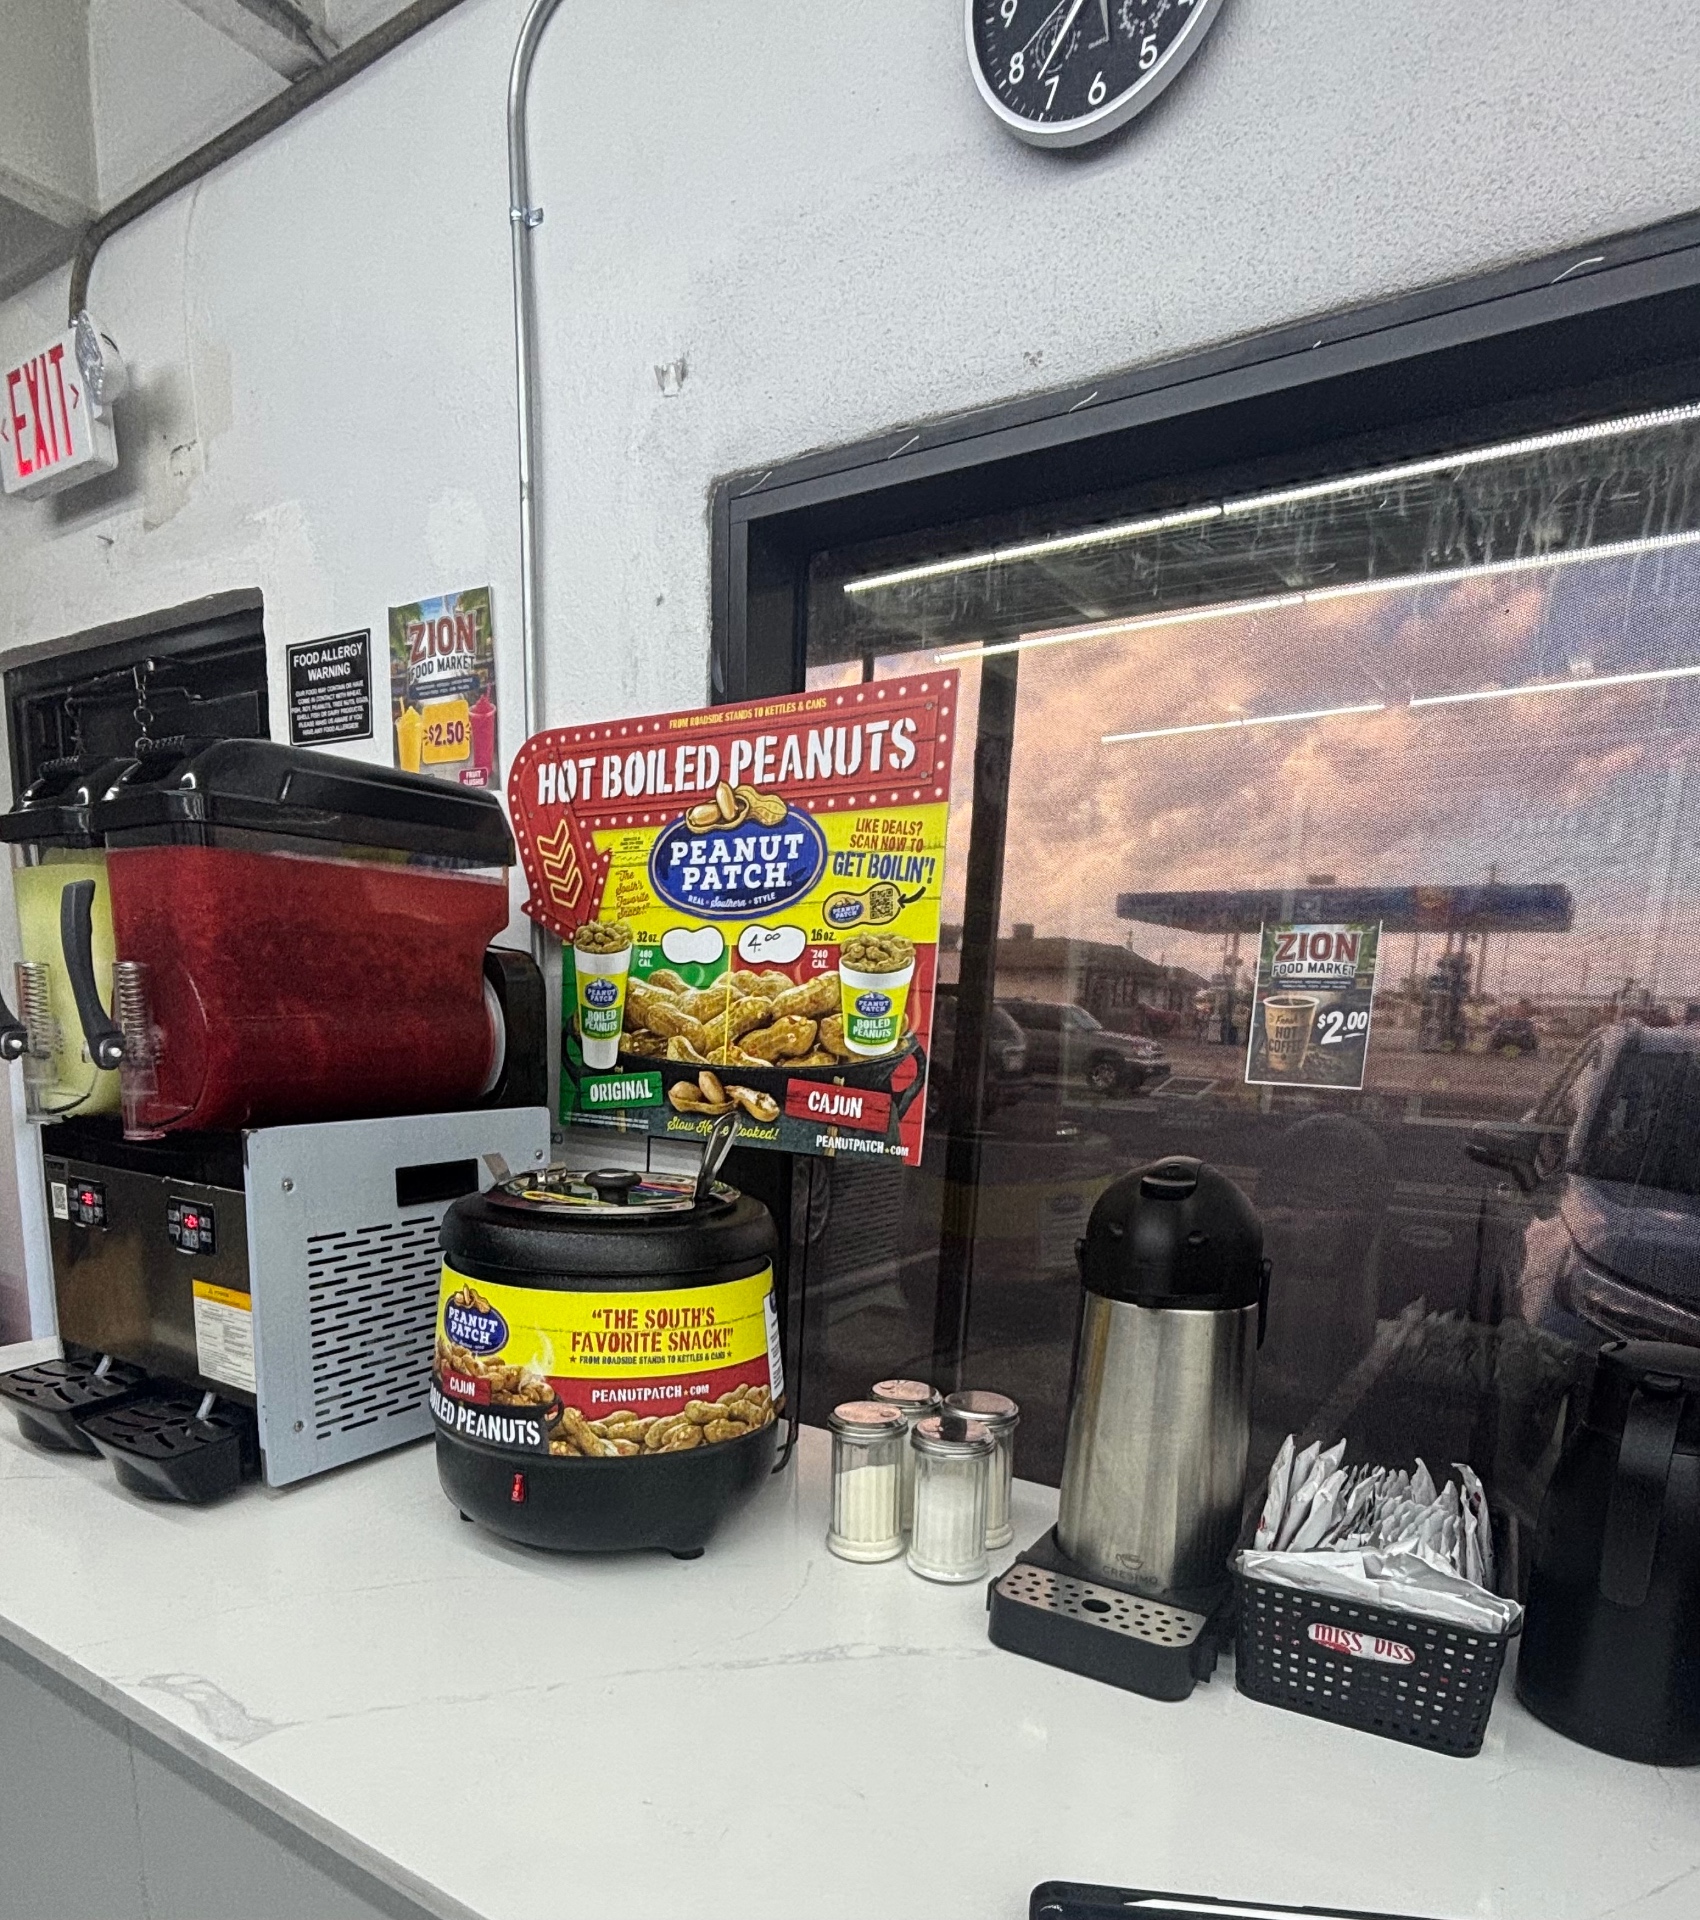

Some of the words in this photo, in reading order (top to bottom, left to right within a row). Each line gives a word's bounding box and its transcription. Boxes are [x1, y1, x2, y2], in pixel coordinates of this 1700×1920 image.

[1000, 0, 1017, 28] 9
[1138, 34, 1157, 69] 5
[1008, 52, 1024, 84] 8
[1044, 76, 1059, 111] 7
[1087, 71, 1106, 105] 6
[7, 342, 73, 477] EXIT
[409, 611, 476, 666] ZION
[293, 651, 319, 668] FOOD
[320, 642, 363, 663] ALLERGY
[307, 662, 351, 681] WARNING
[410, 660, 434, 680] FOOD
[437, 655, 475, 673] MARKET
[669, 717, 689, 730] FROM
[690, 713, 723, 726] ROADSIDE
[725, 708, 752, 722] STANDS
[754, 708, 764, 718] TO
[765, 702, 796, 716] KETTLES
[798, 701, 804, 711] &
[805, 698, 827, 710] CANS
[428, 720, 464, 746] $2.50
[537, 757, 596, 806] HOT
[601, 745, 720, 799] BOILED
[728, 717, 917, 789] PEANUTS
[856, 818, 879, 833] LIKE
[881, 819, 923, 836] DEALS?
[670, 833, 804, 866] PEANUT
[849, 834, 879, 850] SCAN
[881, 836, 907, 852] NOW
[910, 838, 924, 853] TO
[681, 862, 789, 891] PATCH
[832, 851, 866, 878] GET
[867, 853, 935, 884] BOILIN'!
[687, 894, 705, 906] REAL
[710, 896, 747, 908] Southern
[753, 892, 776, 905] STYLE
[833, 904, 860, 915] PEANUT
[835, 911, 858, 919] PATCH
[637, 931, 648, 943] 32
[811, 928, 823, 941] 16
[812, 949, 828, 959] 240
[1275, 931, 1362, 963] ZION
[1273, 963, 1304, 976] FOOD
[1307, 963, 1357, 977] MARKET
[587, 988, 616, 996] PEANUT
[585, 1018, 618, 1032] PEANUTS
[587, 1009, 617, 1022] BOILED
[856, 1018, 891, 1029] BOILED
[853, 1025, 892, 1039] PEANUTS
[1276, 1026, 1298, 1039] HOT
[1317, 1011, 1368, 1045] $2.00
[590, 1079, 653, 1103] ORIGINAL
[807, 1091, 863, 1119] CAJUN
[667, 1116, 695, 1132] Slow
[448, 1306, 498, 1334] PEANUT
[592, 1309, 638, 1330] "THE
[644, 1307, 715, 1330] SOUTH'S
[450, 1321, 490, 1345] PATCH
[571, 1331, 662, 1353] FAVORITE
[667, 1328, 733, 1352] SNACK!"
[579, 1355, 600, 1365] FROM
[602, 1355, 637, 1365] ROADSIDE
[639, 1355, 666, 1365] STANDS
[667, 1355, 676, 1364] TO
[677, 1353, 704, 1363] KETTLES
[704, 1352, 710, 1361] &
[710, 1351, 725, 1361] CANS
[449, 1376, 476, 1397] CAJUN
[456, 1405, 541, 1446] PEANUTS
[1315, 1624, 1363, 1652] MISS
